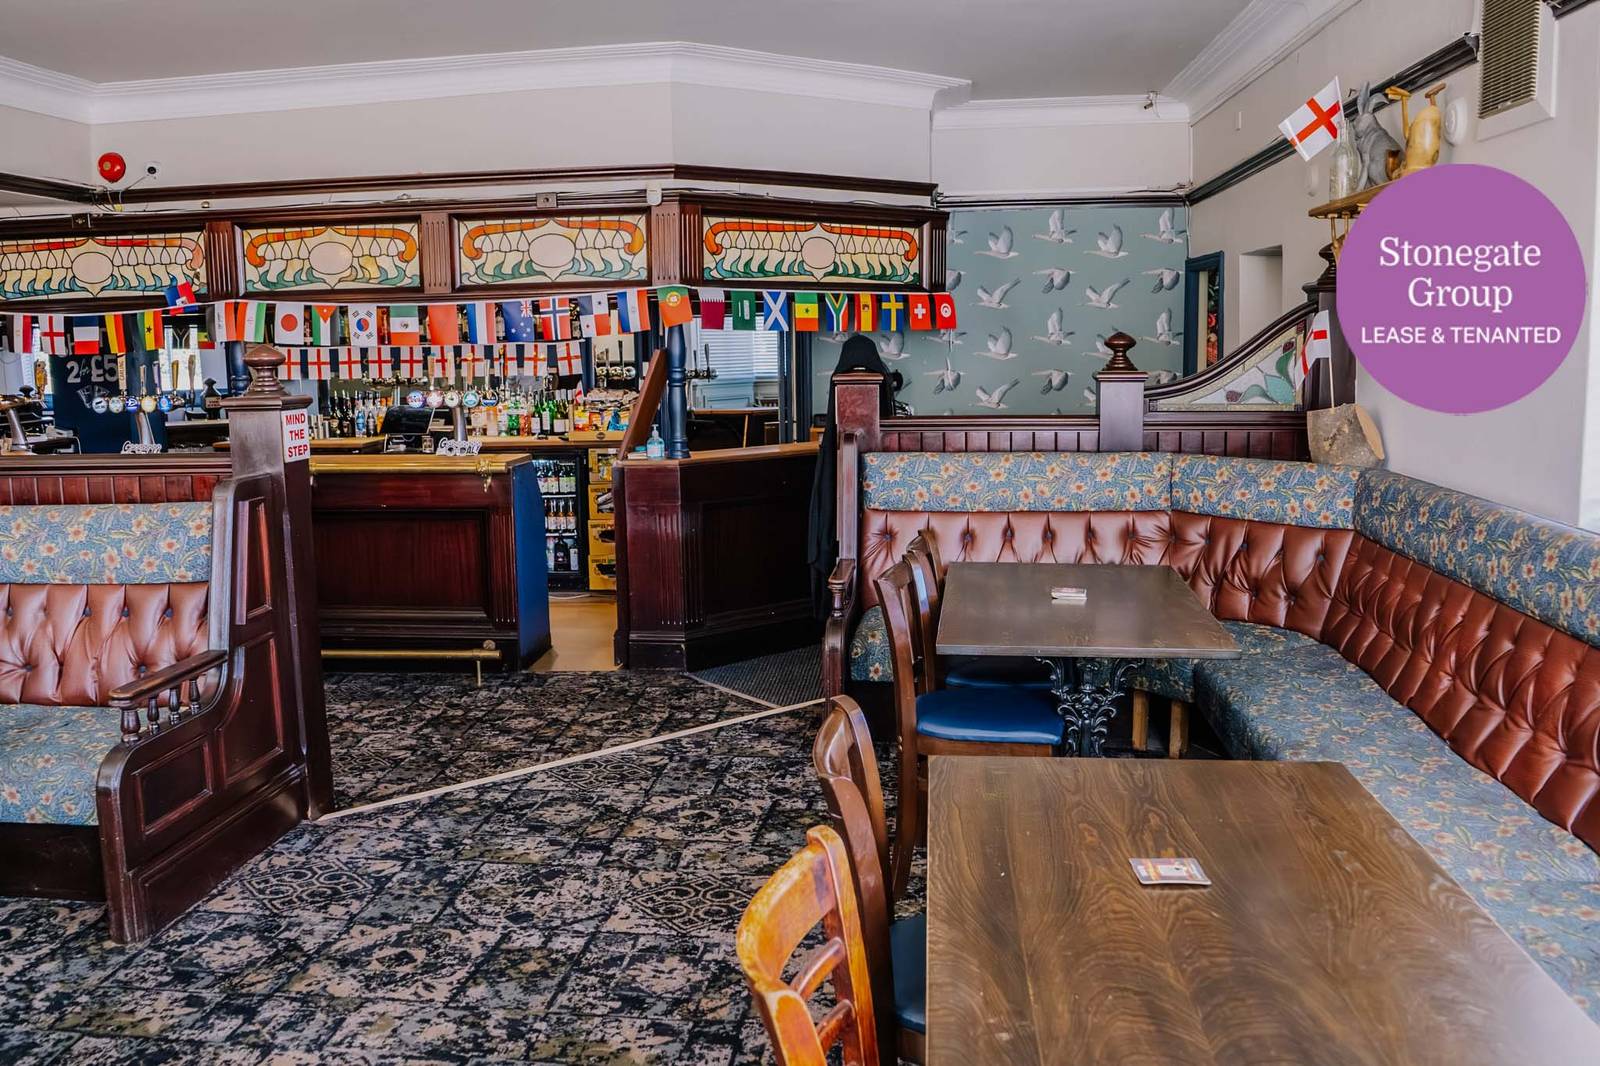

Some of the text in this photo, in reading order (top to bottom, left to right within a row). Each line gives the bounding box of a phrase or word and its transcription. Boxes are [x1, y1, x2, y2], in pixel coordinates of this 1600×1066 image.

[66, 360, 81, 383] 2
[91, 354, 118, 382] £5
[285, 413, 305, 425] MIND
[290, 429, 305, 440] THE
[288, 444, 308, 457] STEP
